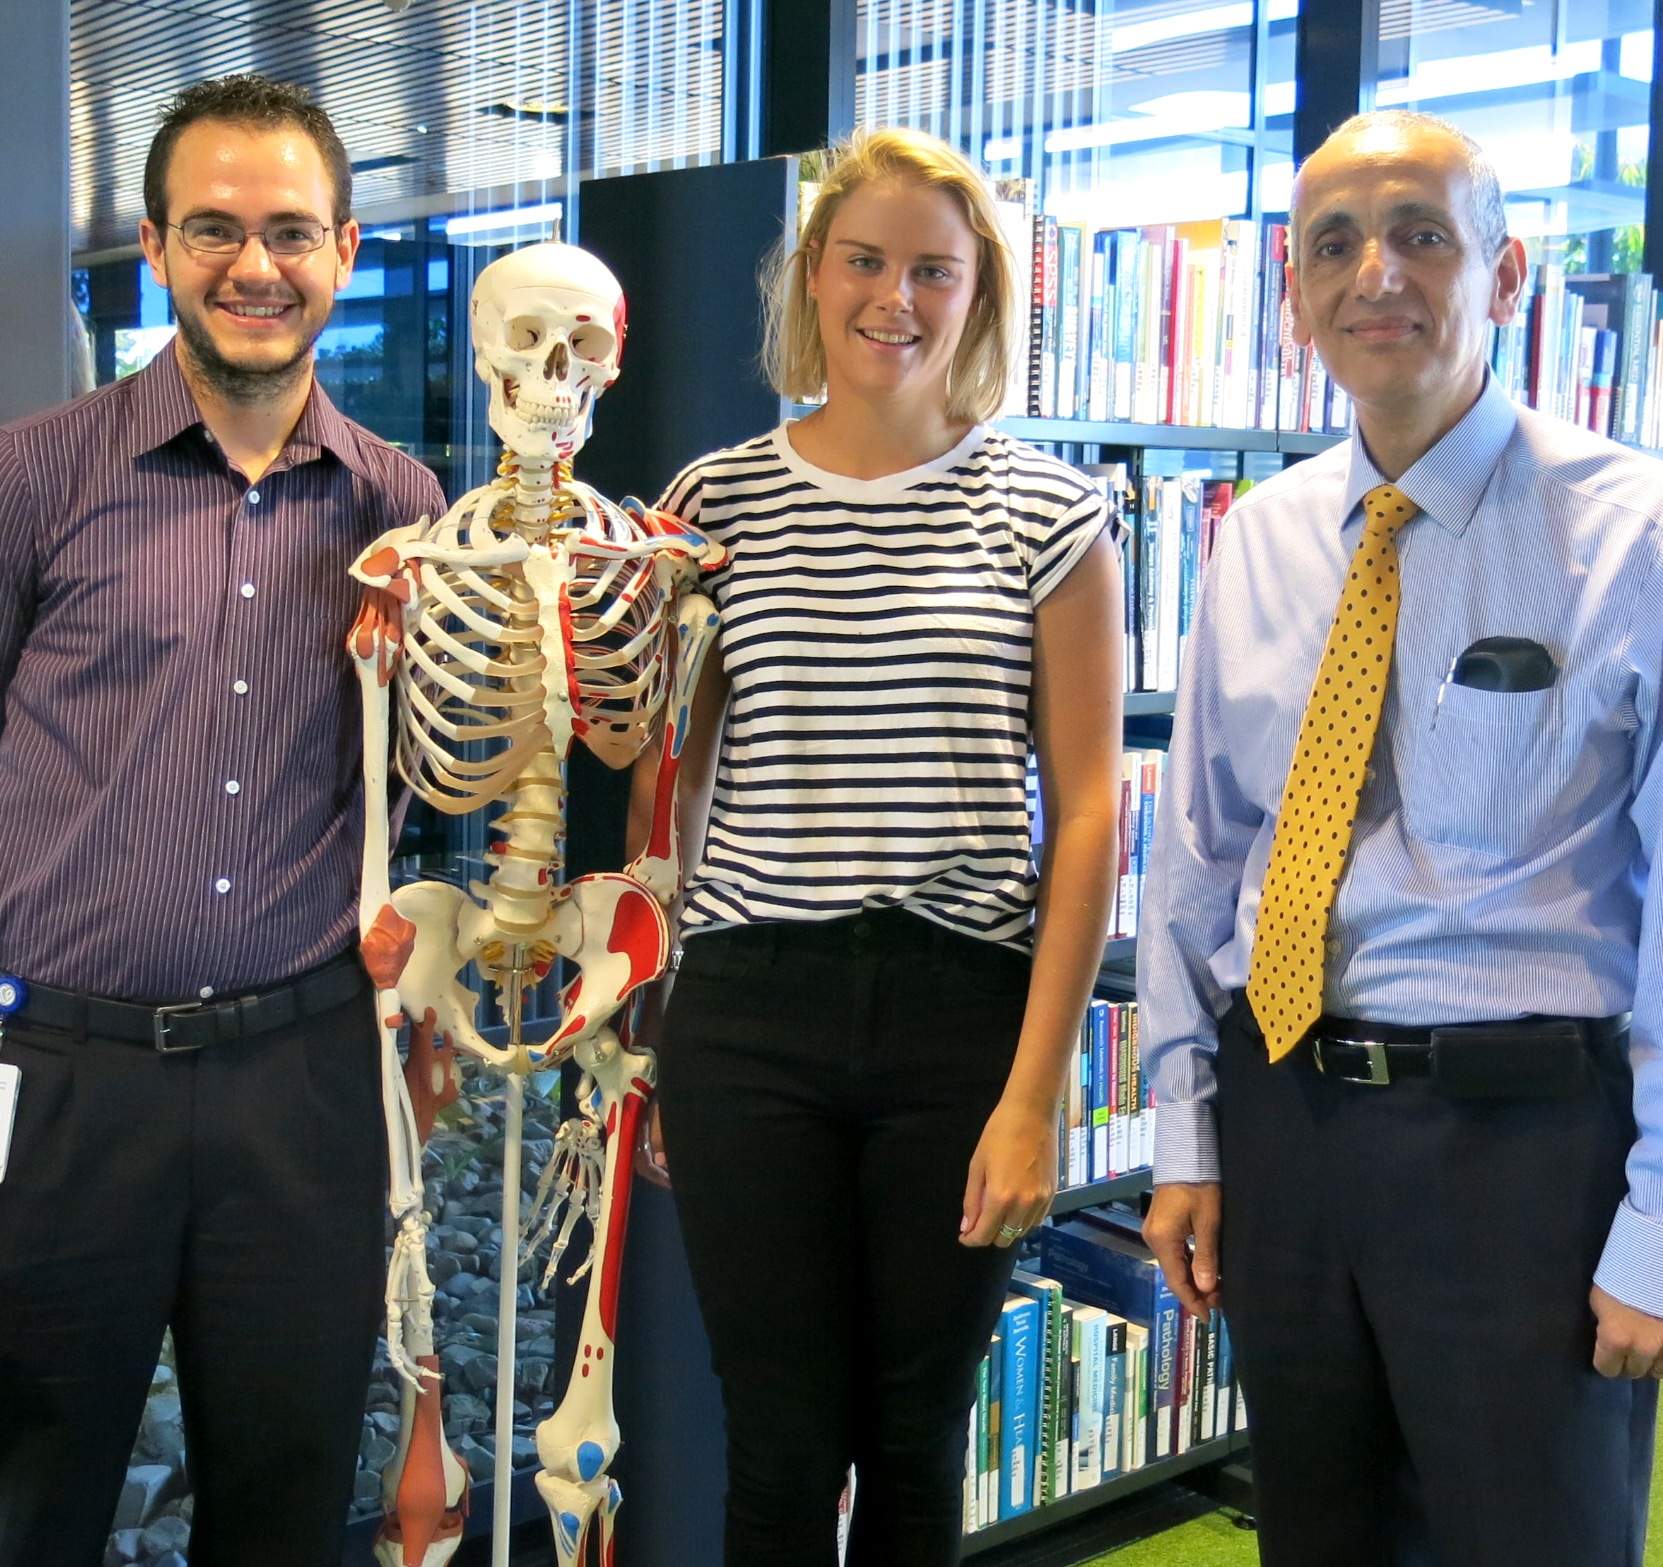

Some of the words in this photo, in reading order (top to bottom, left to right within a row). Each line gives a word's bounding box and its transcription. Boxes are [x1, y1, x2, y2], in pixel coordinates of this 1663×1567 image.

[1130, 1013, 1138, 1072] INDIGENOUS
[1092, 1323, 1100, 1367] HOSPITAL
[1158, 1308, 1175, 1391] Pathology
[1206, 1333, 1215, 1360] BASIC
[1109, 1357, 1118, 1385] Family
[1109, 1386, 1117, 1416] Medici
